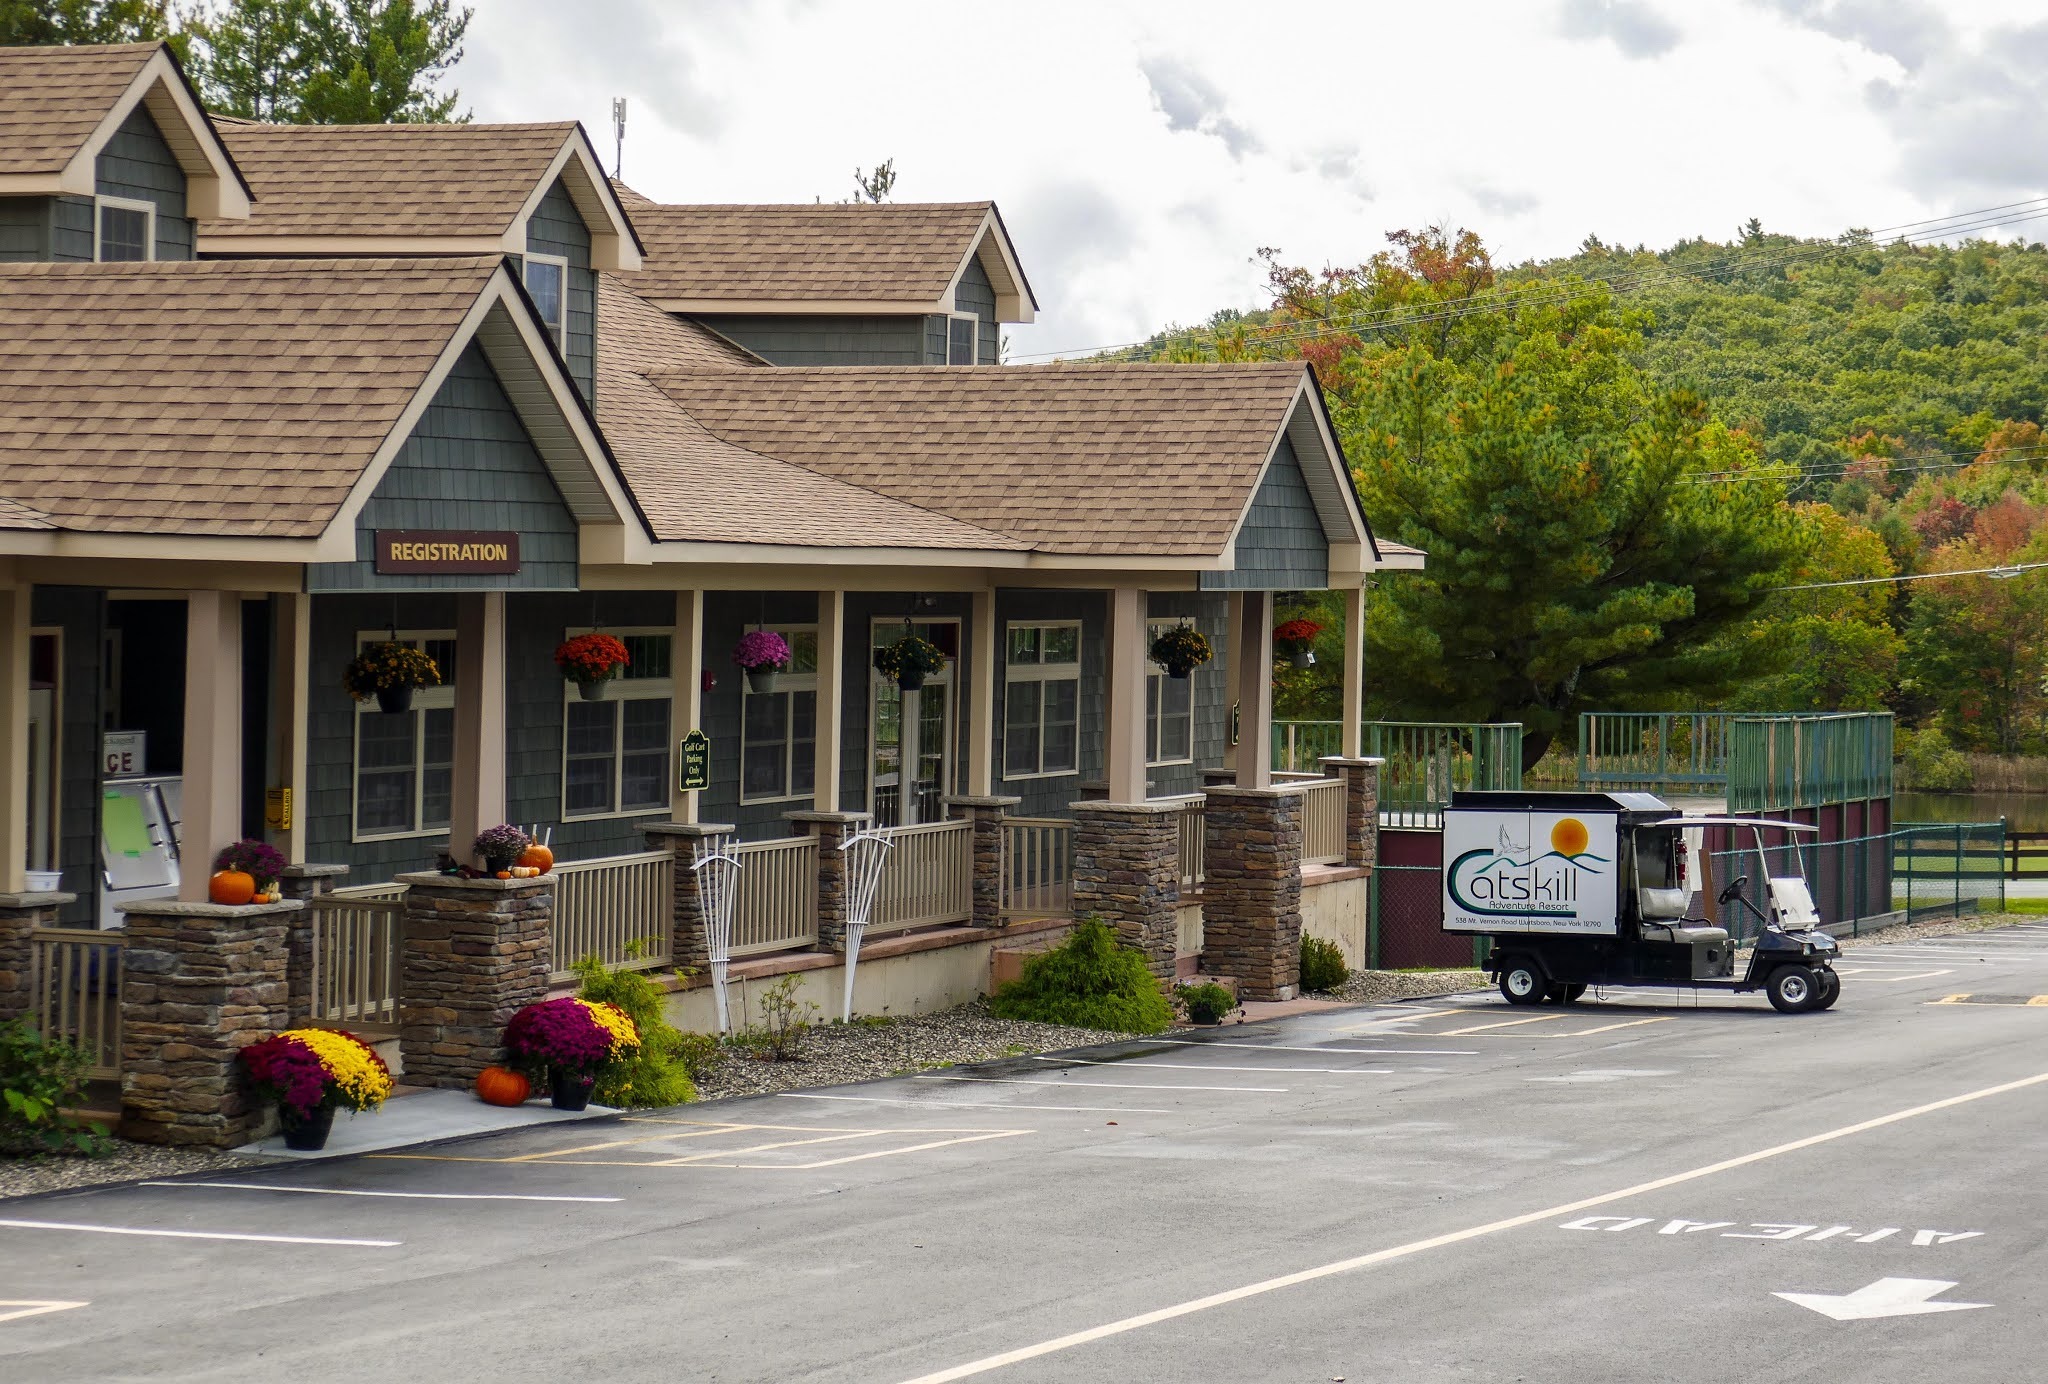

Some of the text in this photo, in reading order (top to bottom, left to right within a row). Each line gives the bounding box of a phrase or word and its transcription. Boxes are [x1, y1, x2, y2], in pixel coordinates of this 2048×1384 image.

[391, 543, 508, 561] REGISTRATION
[685, 743, 706, 751] Golf Cart
[107, 752, 132, 773] CE
[687, 754, 703, 765] Parking
[689, 766, 700, 776] Only
[1447, 848, 1577, 918] Catskill
[1489, 900, 1569, 911] Adventure Resort
[1501, 918, 1517, 926] Road
[1518, 919, 1552, 927] Wurtsboro,
[1583, 920, 1602, 928] 12790
[1559, 1216, 1985, 1246] AHEAD
